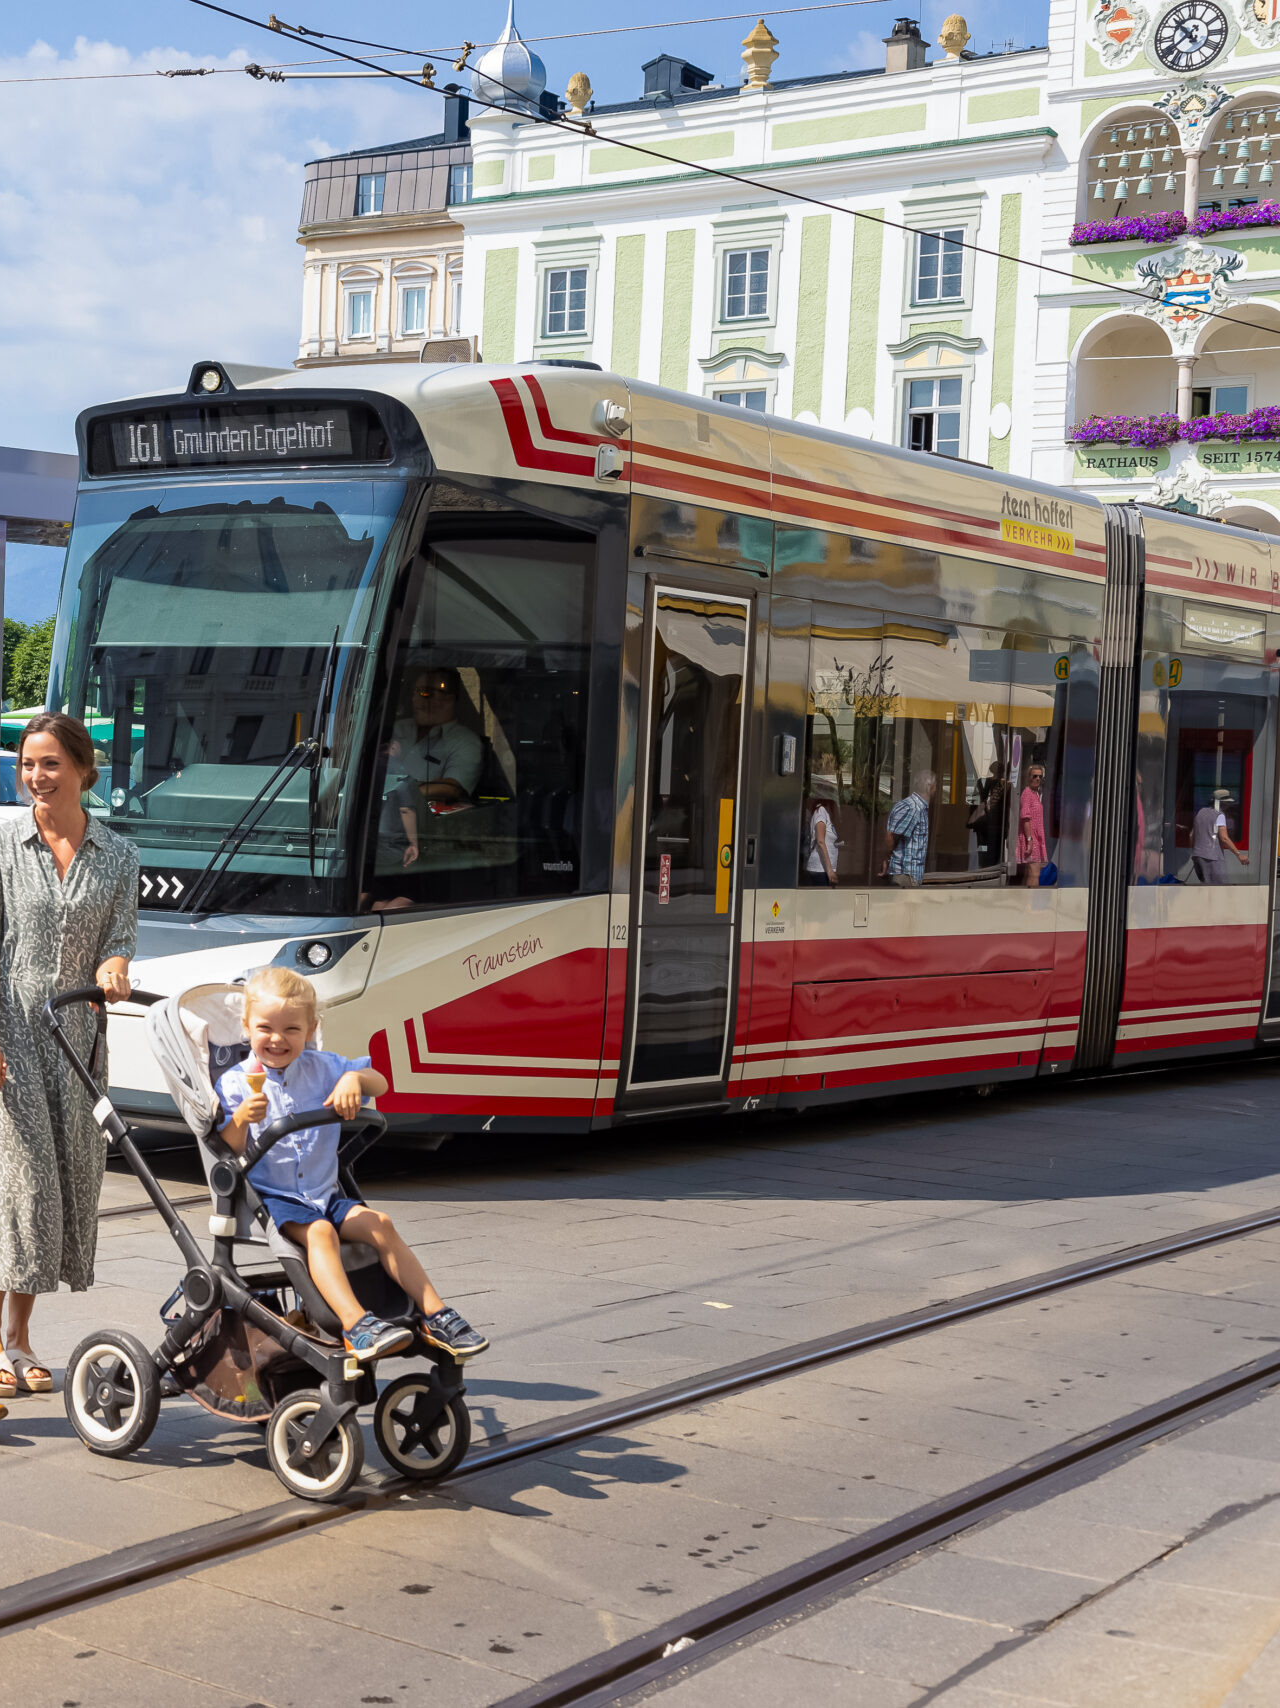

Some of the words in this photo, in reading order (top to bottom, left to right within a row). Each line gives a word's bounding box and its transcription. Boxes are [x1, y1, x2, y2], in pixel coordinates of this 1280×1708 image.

[128, 423, 162, 463] 161
[173, 427, 252, 455] Gmunden
[253, 420, 335, 455] Engelhof
[1086, 456, 1159, 469] RATHAUS
[1203, 452, 1240, 464] SEIT
[1246, 450, 1280, 463] 1574
[1001, 491, 1031, 520] stern
[1034, 496, 1073, 530] hafferl
[1005, 522, 1053, 548] VERKEHR
[1226, 562, 1257, 586] WIR
[611, 924, 627, 941] 122
[462, 934, 544, 980] Traunstein
